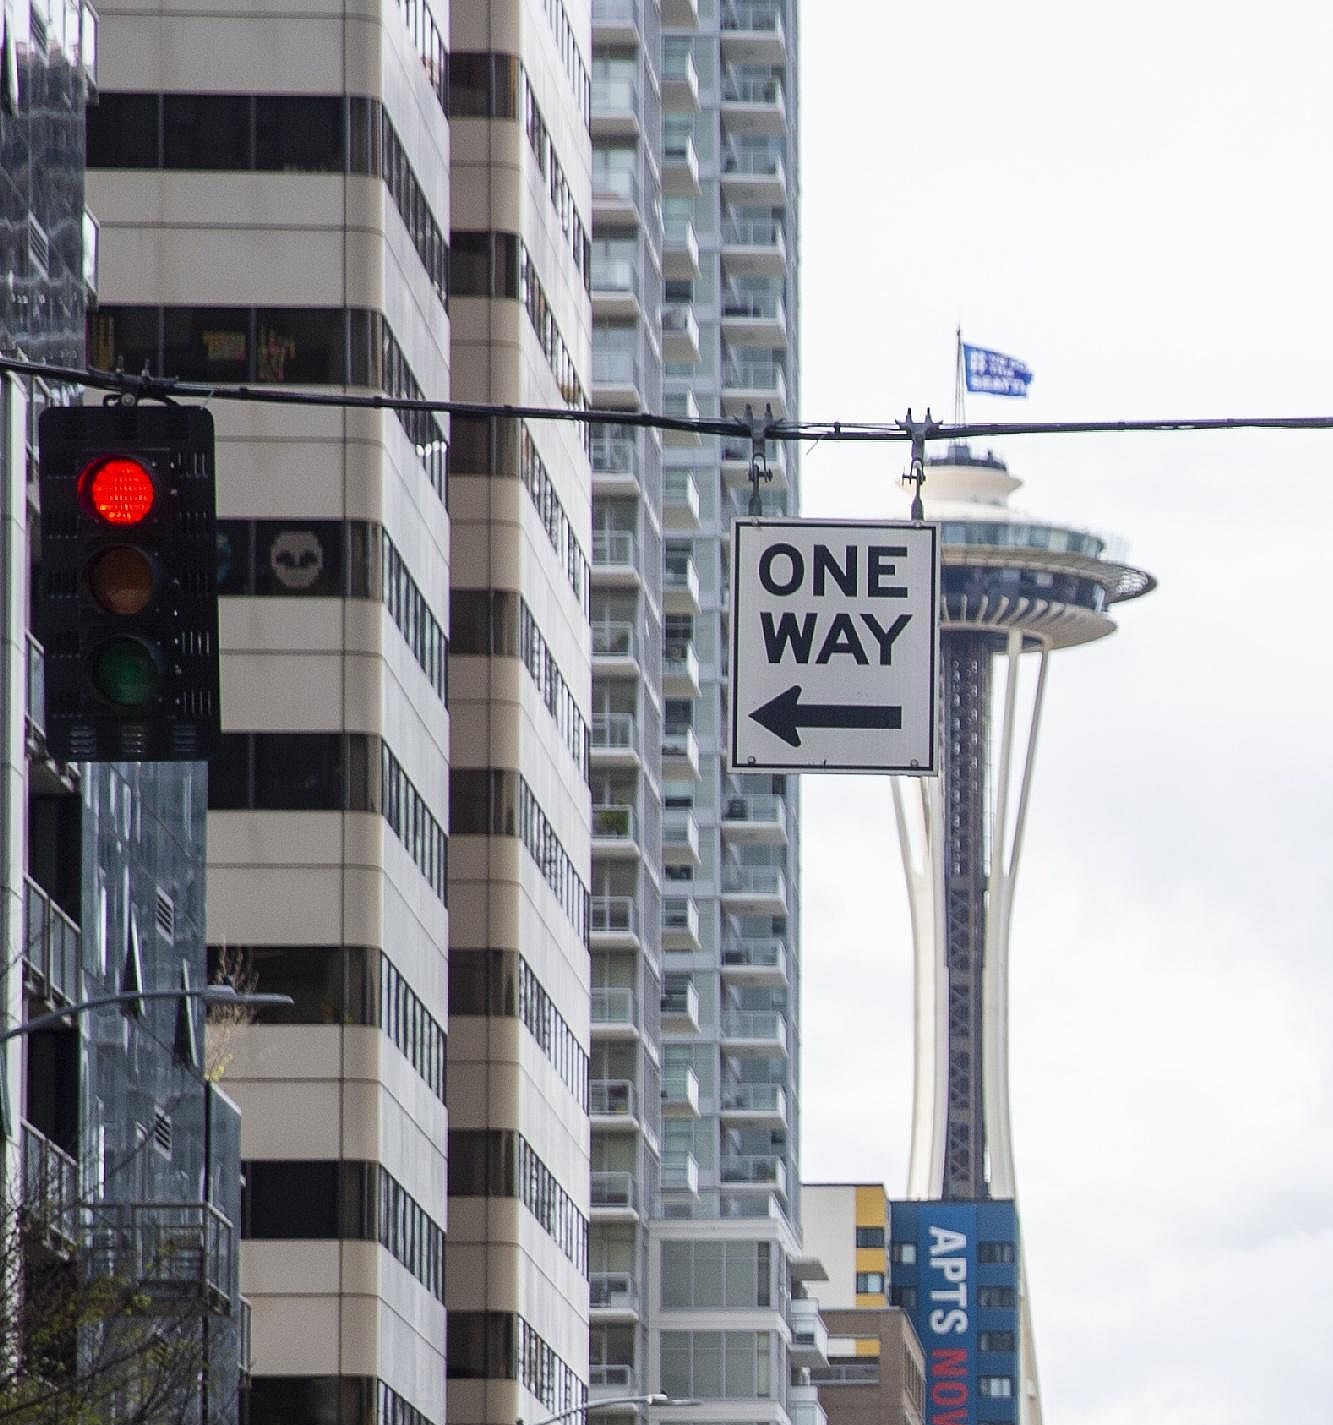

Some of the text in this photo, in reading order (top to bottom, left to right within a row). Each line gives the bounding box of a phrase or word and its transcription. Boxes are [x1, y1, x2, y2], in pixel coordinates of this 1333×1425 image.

[758, 542, 908, 598] ONE
[759, 612, 912, 666] WAY
[928, 1225, 967, 1335] APTS
